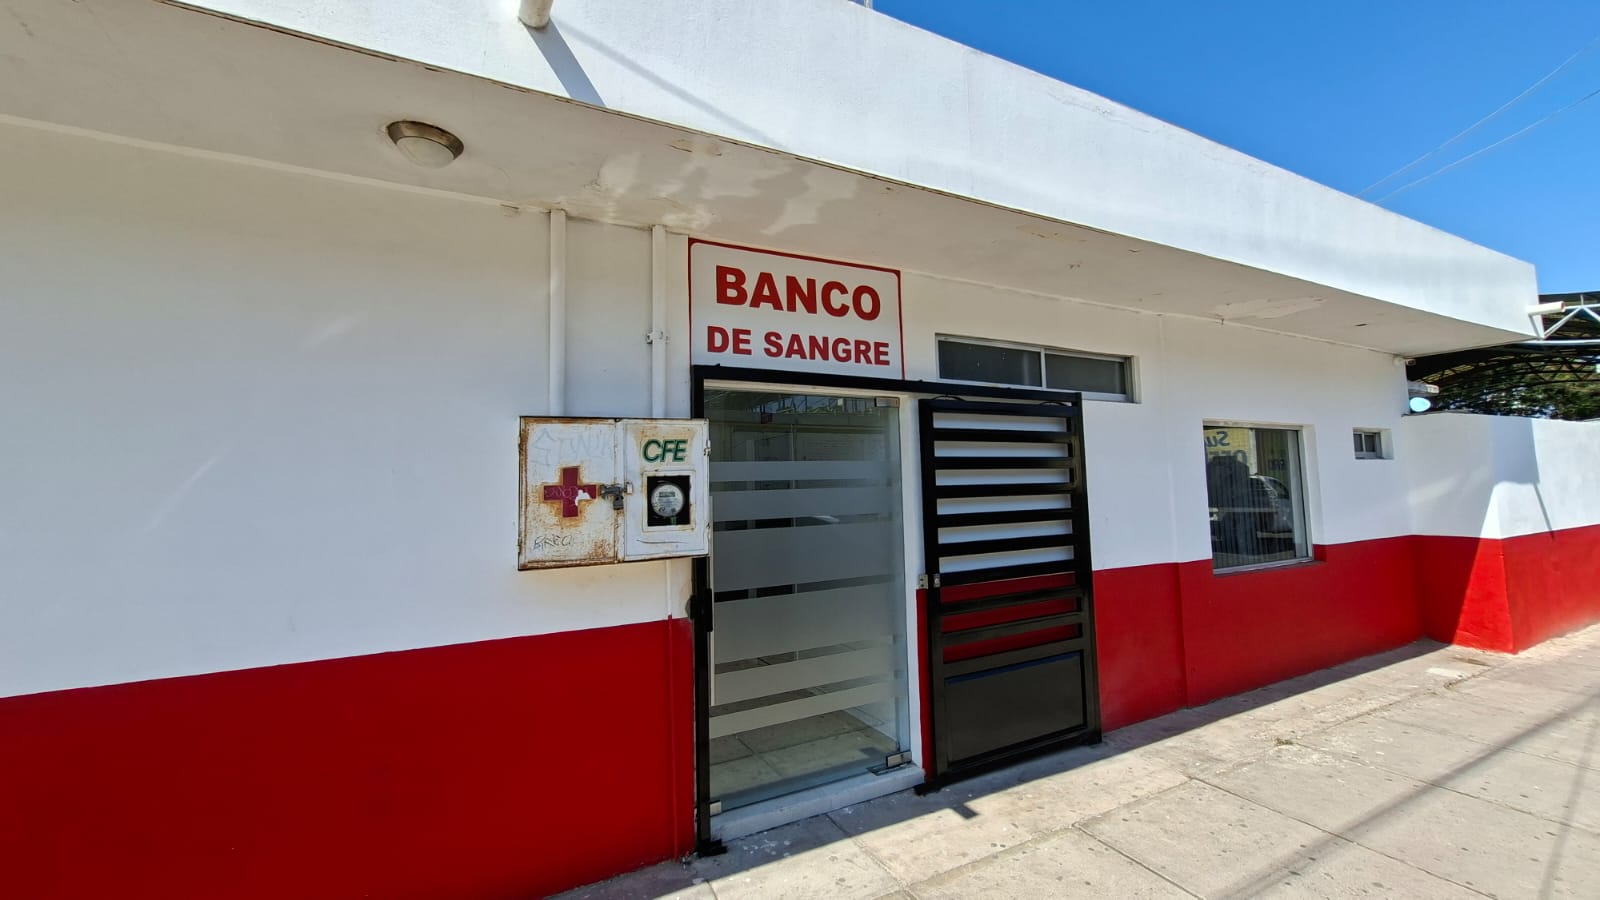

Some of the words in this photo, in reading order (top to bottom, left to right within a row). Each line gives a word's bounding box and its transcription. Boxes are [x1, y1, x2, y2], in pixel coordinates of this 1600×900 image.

[716, 265, 881, 321] BANCO
[707, 325, 752, 355] DE
[763, 332, 889, 365] SANGRE
[643, 439, 688, 462] CFE
